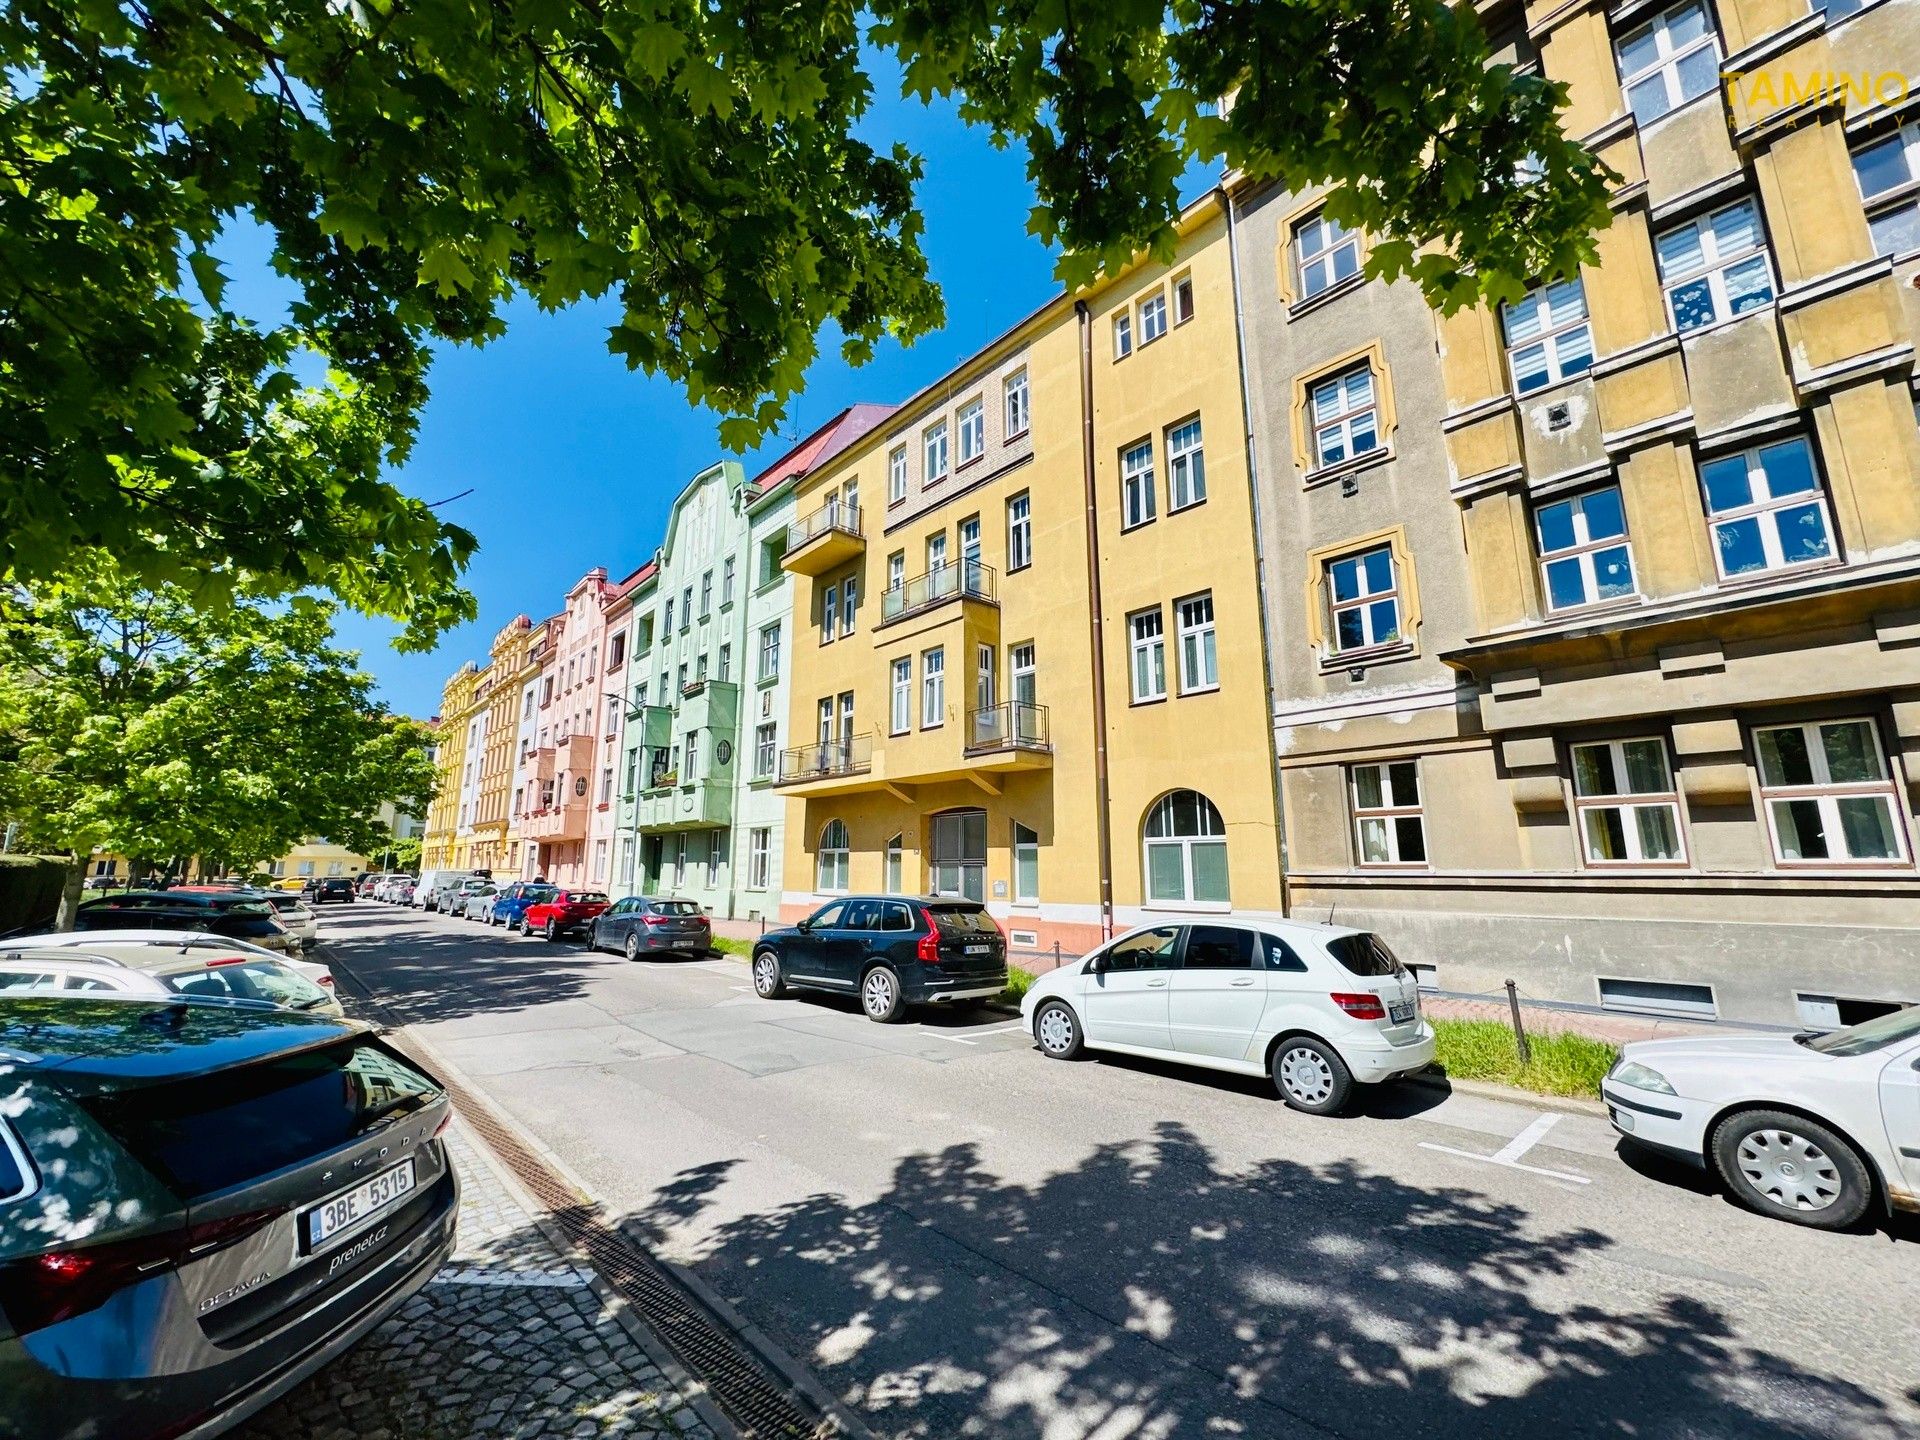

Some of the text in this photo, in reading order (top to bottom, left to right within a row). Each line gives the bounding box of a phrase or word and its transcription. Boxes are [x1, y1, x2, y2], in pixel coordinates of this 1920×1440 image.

[325, 1192, 359, 1232] 3BE
[369, 1166, 408, 1206] 5315
[328, 1224, 389, 1275] prenet.cz
[200, 1272, 271, 1311] OCTAVIA
